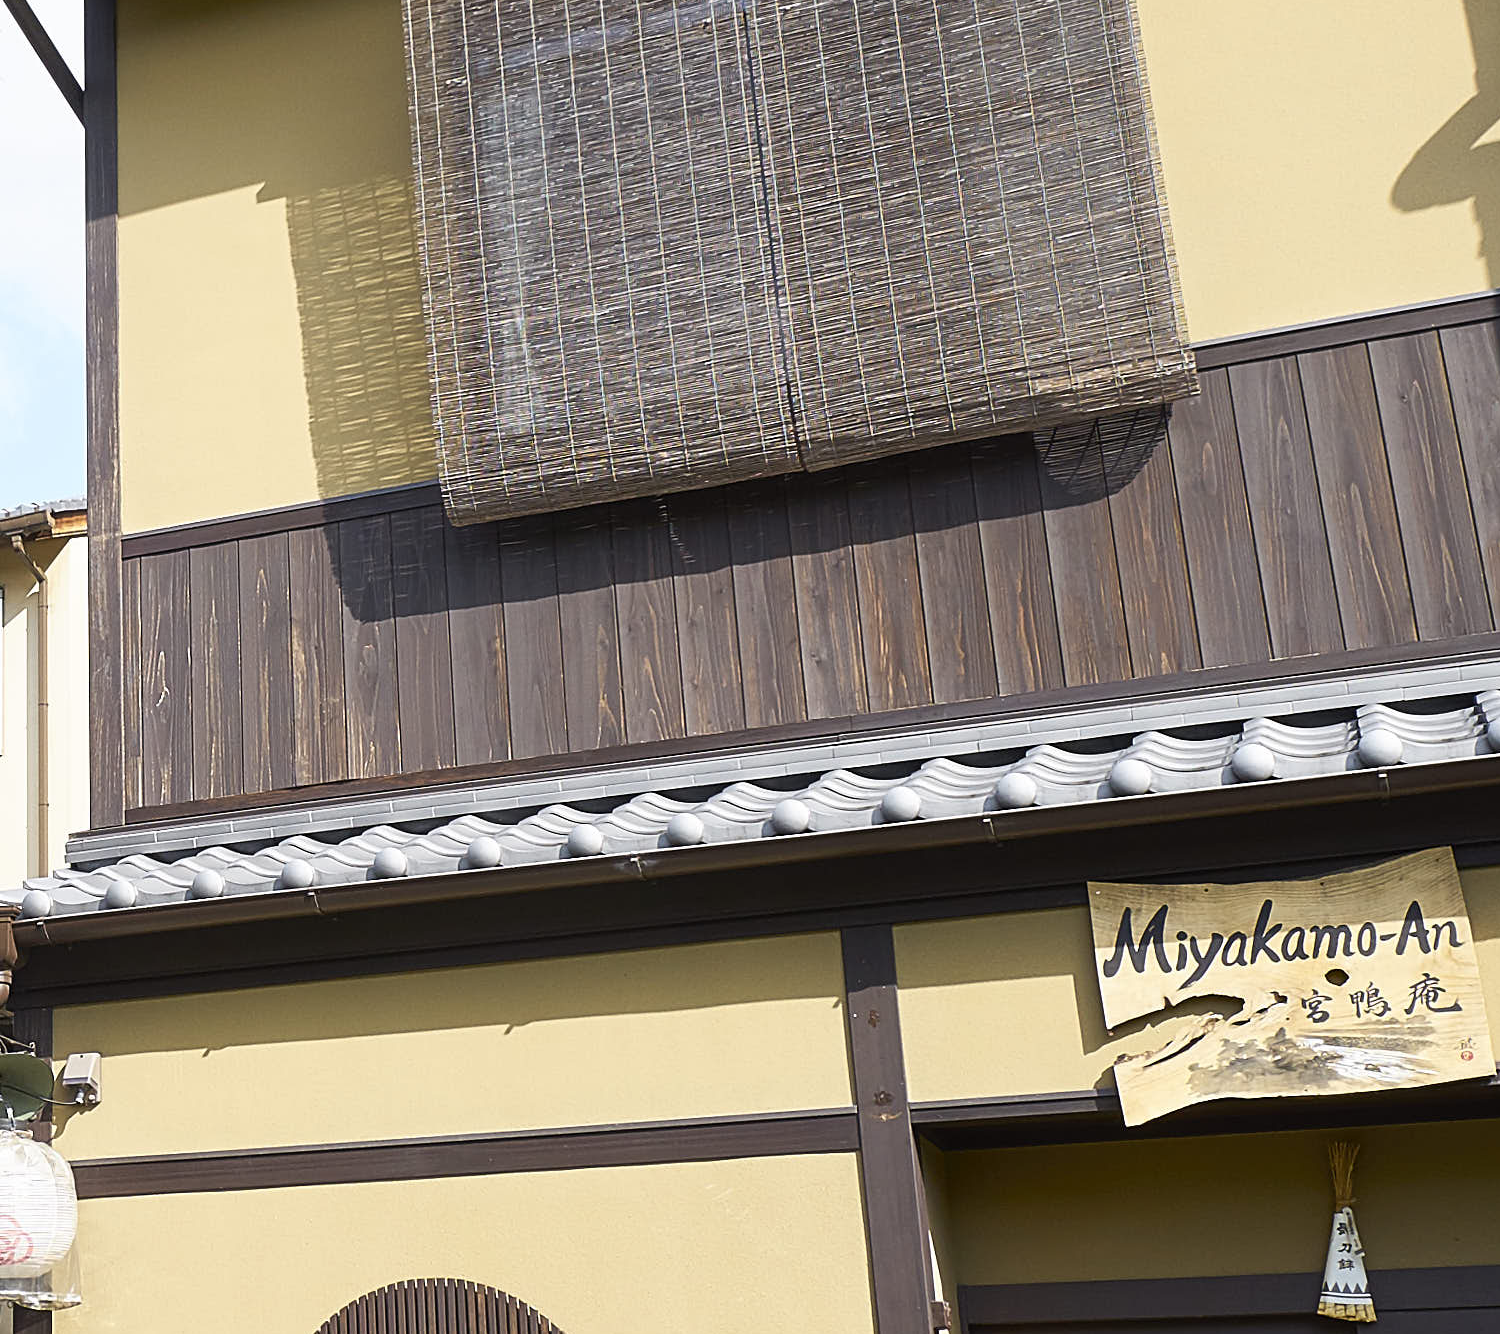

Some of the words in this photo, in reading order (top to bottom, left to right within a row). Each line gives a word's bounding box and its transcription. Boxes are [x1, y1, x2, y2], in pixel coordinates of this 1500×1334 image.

[1103, 899, 1464, 990] Miyakamo-An
[1301, 972, 1463, 1024] 宮鴨庵
